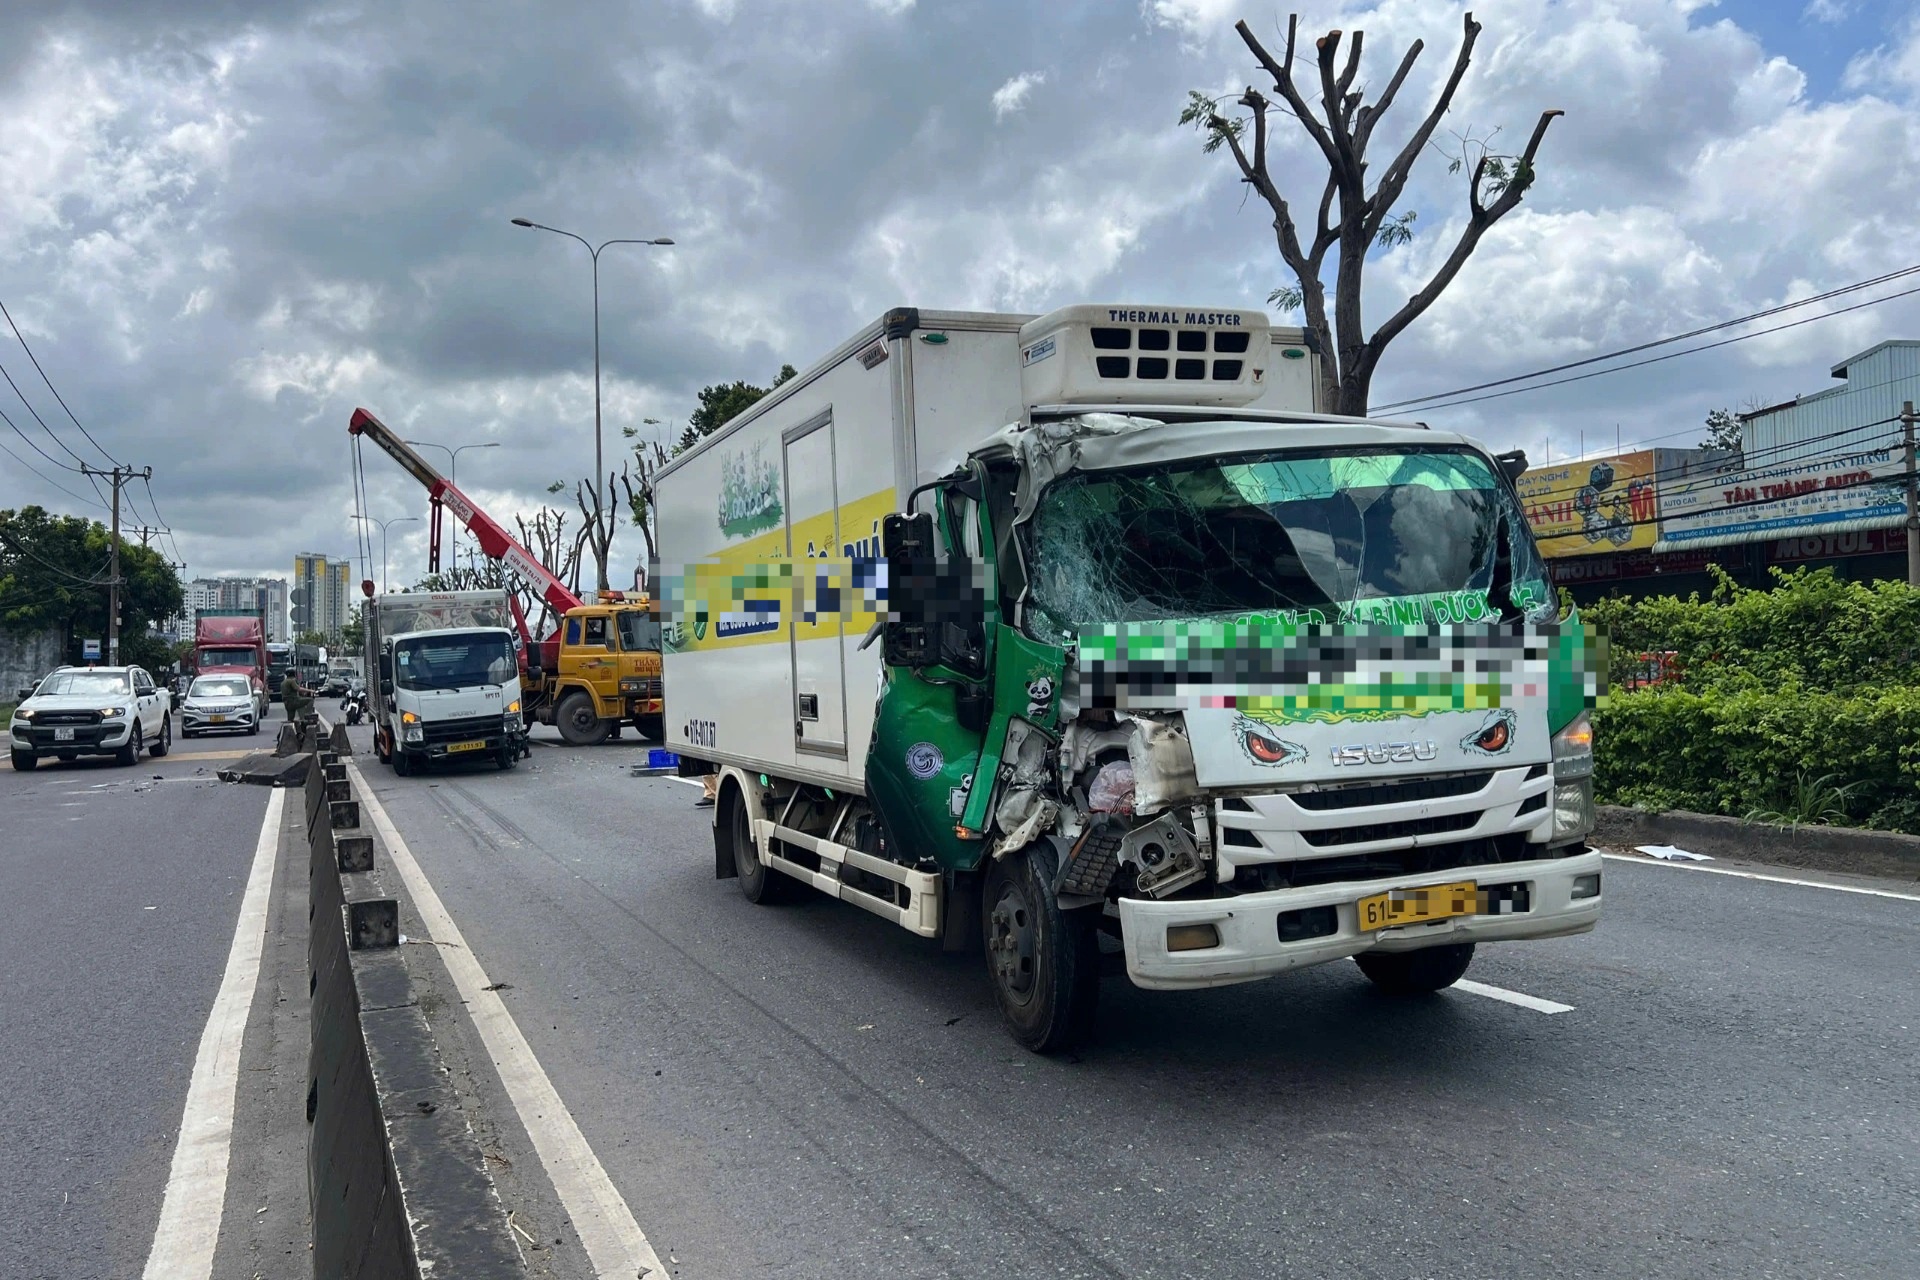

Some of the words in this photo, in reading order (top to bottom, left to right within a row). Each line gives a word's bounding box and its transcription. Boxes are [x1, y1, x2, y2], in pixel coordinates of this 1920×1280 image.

[1109, 309, 1179, 324] THERMAL
[1185, 312, 1241, 326] MASTER
[1722, 486, 1757, 504] TÂN
[1759, 478, 1819, 501] THÀNH
[1825, 471, 1873, 489] AUTO
[1683, 497, 1697, 505] CAR
[1774, 531, 1873, 558] MOTUL
[1555, 558, 1617, 581] MOTUL
[1330, 740, 1437, 767] ISUZU
